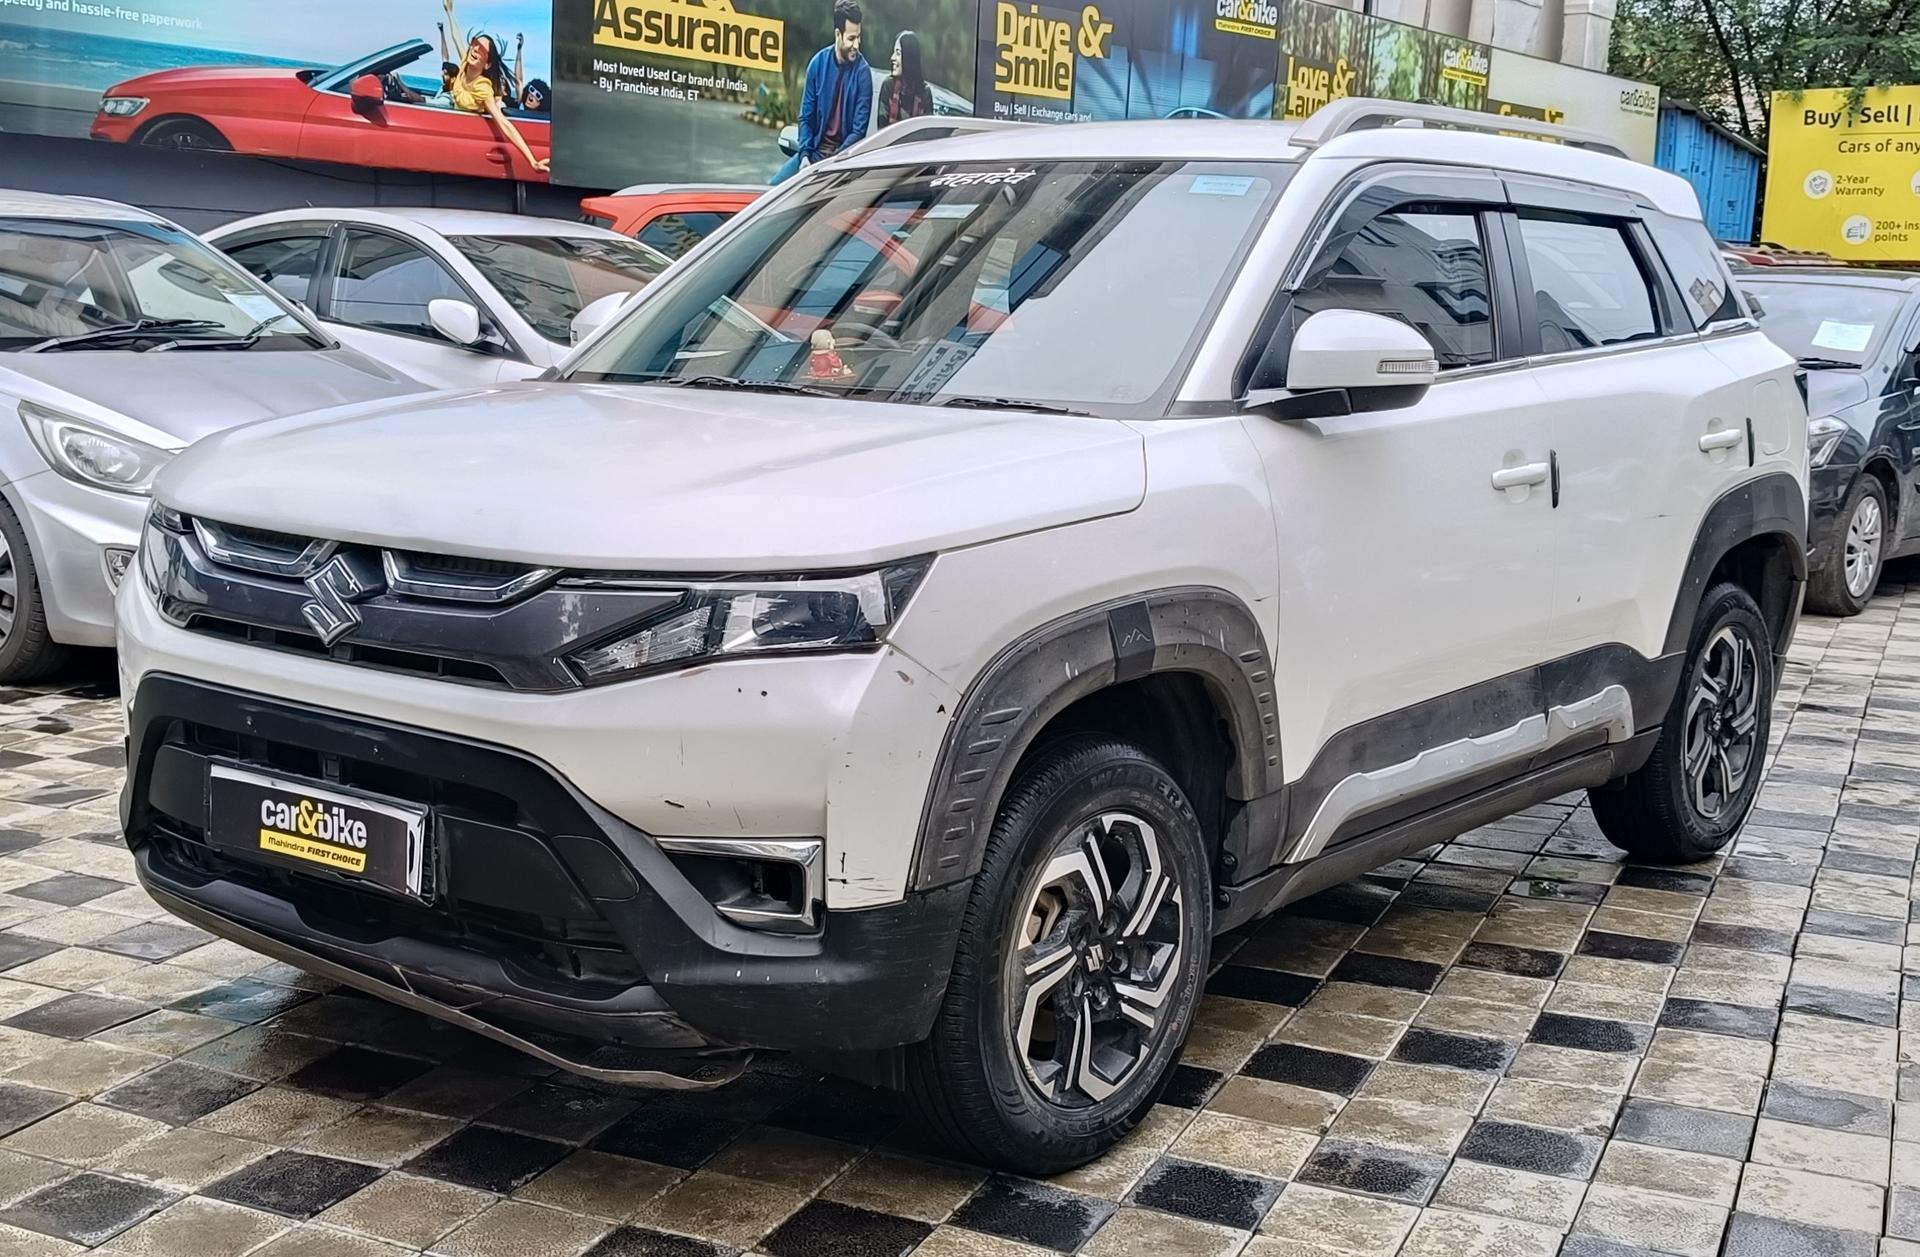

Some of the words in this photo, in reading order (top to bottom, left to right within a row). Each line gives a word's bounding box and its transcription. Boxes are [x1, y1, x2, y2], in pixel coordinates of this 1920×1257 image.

[46, 0, 69, 11] and
[72, 0, 139, 21] hassle-free
[142, 13, 202, 29] paperwork
[1216, 0, 1278, 26] car&bike
[593, 0, 780, 63] Assurance
[997, 2, 1071, 50] Drive
[1078, 5, 1112, 58] &
[593, 58, 618, 73] Most
[620, 62, 645, 77] loved
[647, 67, 670, 80] Used
[672, 71, 687, 83] Car
[688, 72, 714, 87] brand
[716, 77, 726, 88] of
[727, 79, 748, 92] India
[996, 43, 1070, 91] Smile
[1288, 56, 1329, 91] Love
[1333, 58, 1356, 98] &
[600, 77, 613, 92] By
[615, 79, 659, 96] Franchise
[661, 86, 686, 101] India,
[688, 89, 699, 101] ET
[994, 102, 1008, 115] Buy
[1014, 103, 1026, 116] Sell
[1032, 106, 1063, 121] Exchange
[1065, 112, 1078, 121] cars
[1079, 112, 1091, 121] and
[1804, 109, 1842, 128] Buy
[1860, 105, 1899, 123] Sell
[1838, 140, 1871, 153] Cars
[1875, 138, 1893, 152] of
[1896, 141, 1920, 155] any
[1835, 186, 1885, 197] Warranty
[1836, 175, 1870, 184] 2-Year
[1874, 232, 1908, 243] points
[1875, 221, 1901, 230] 200+
[261, 799, 368, 848] car&bike
[268, 836, 305, 852] Mahindra
[307, 846, 332, 858] FIRST
[331, 853, 362, 867] CHOICE
